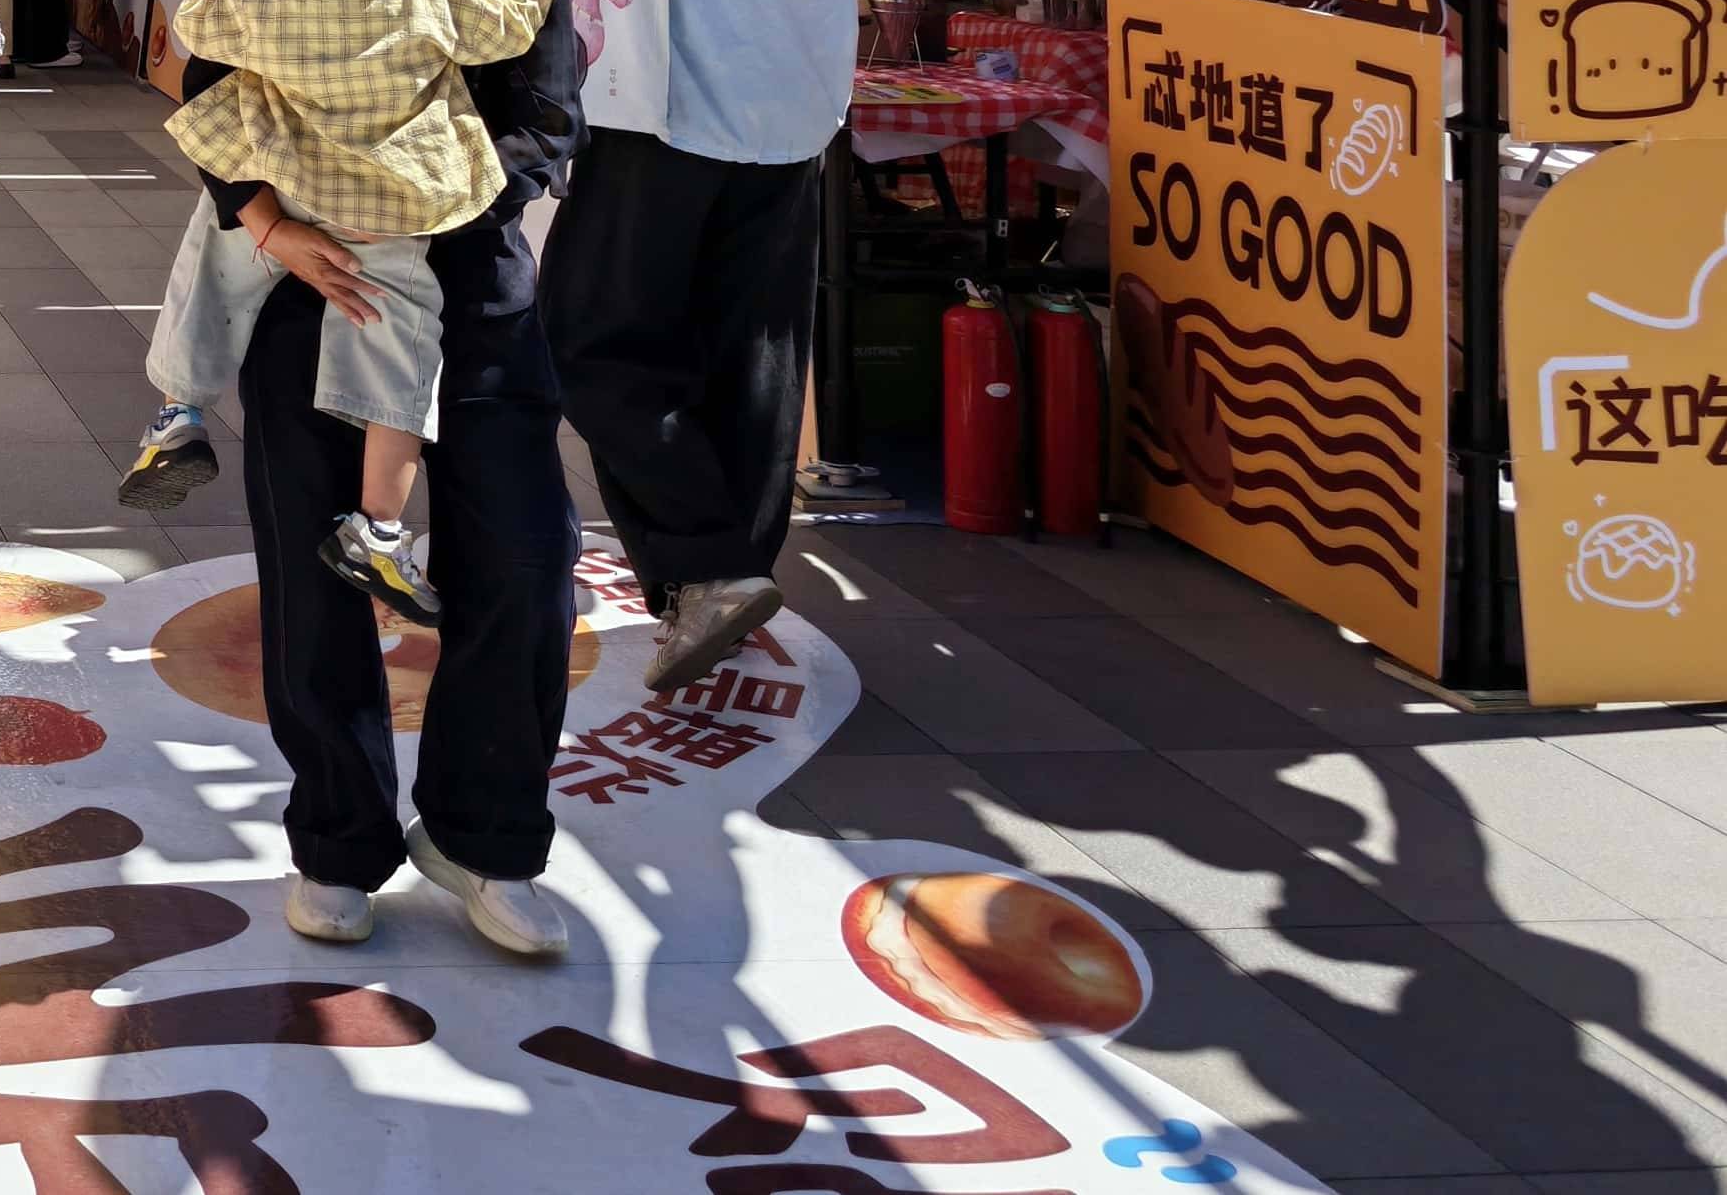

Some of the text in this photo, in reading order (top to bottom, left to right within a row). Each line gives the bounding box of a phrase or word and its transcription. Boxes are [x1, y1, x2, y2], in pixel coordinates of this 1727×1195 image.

[1129, 150, 1414, 339] SO GOOD
[1565, 374, 1727, 467] 这吃
